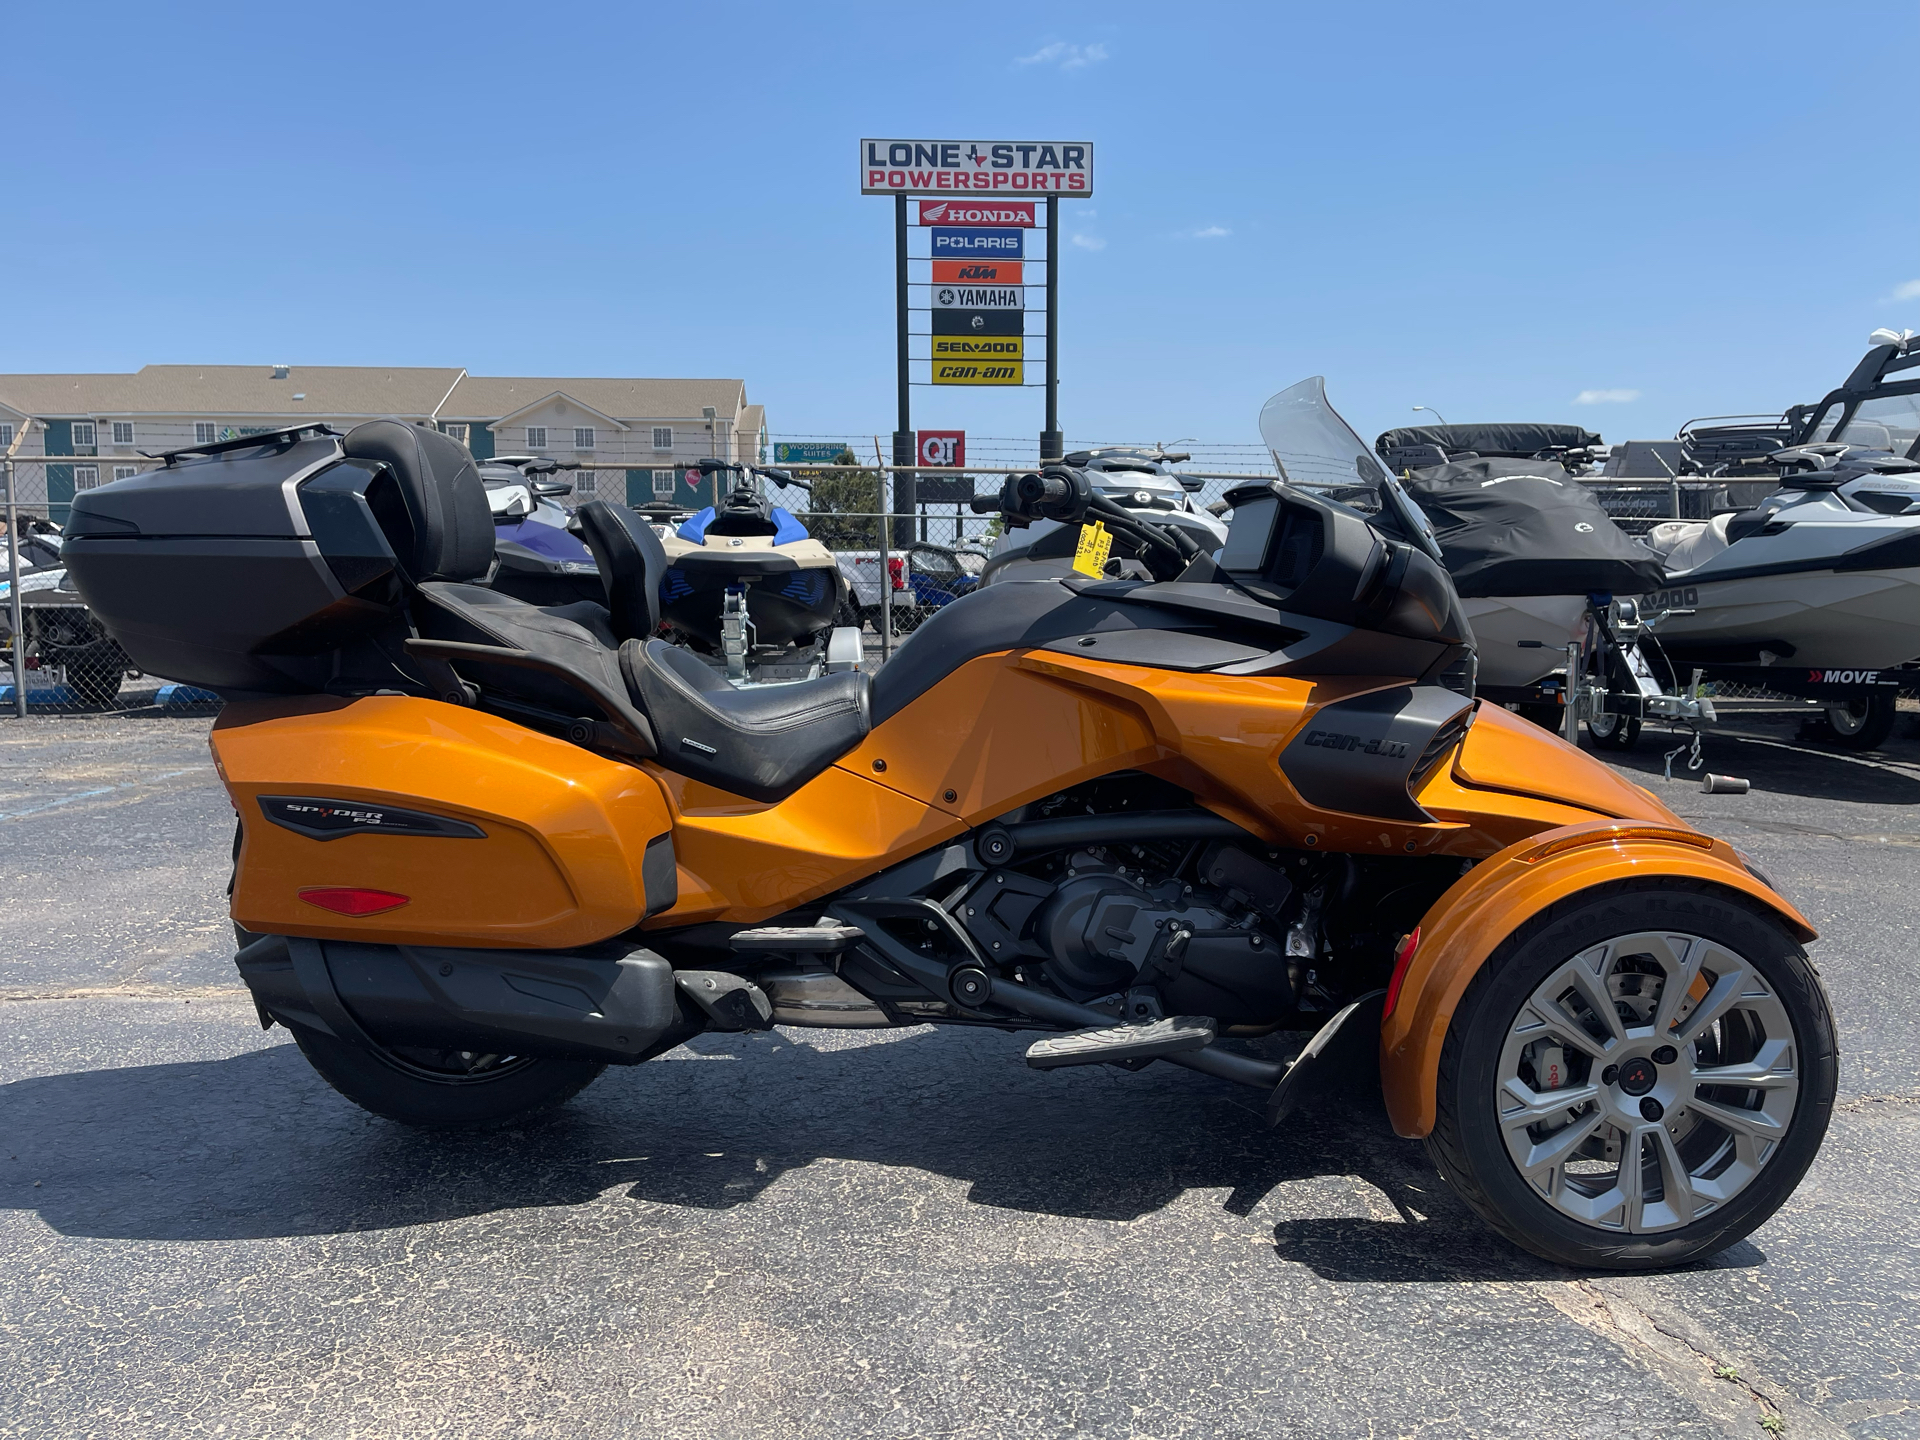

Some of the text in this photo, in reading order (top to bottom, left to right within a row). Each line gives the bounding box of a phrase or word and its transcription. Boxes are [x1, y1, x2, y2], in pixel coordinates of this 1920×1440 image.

[868, 142, 1085, 169] LONE STAR
[868, 170, 1085, 190] POWERSPORTS
[948, 209, 1032, 223] HONDA
[936, 236, 1018, 249] POLARIS
[958, 265, 997, 279] KTM
[957, 289, 1017, 306] YAMAHA
[922, 437, 958, 466] QT
[1823, 670, 1878, 684] MOVE
[1304, 730, 1411, 759] can-am
[286, 804, 383, 819] SPYDER
[353, 817, 381, 825] F3
[1508, 905, 1628, 982] KENDA
